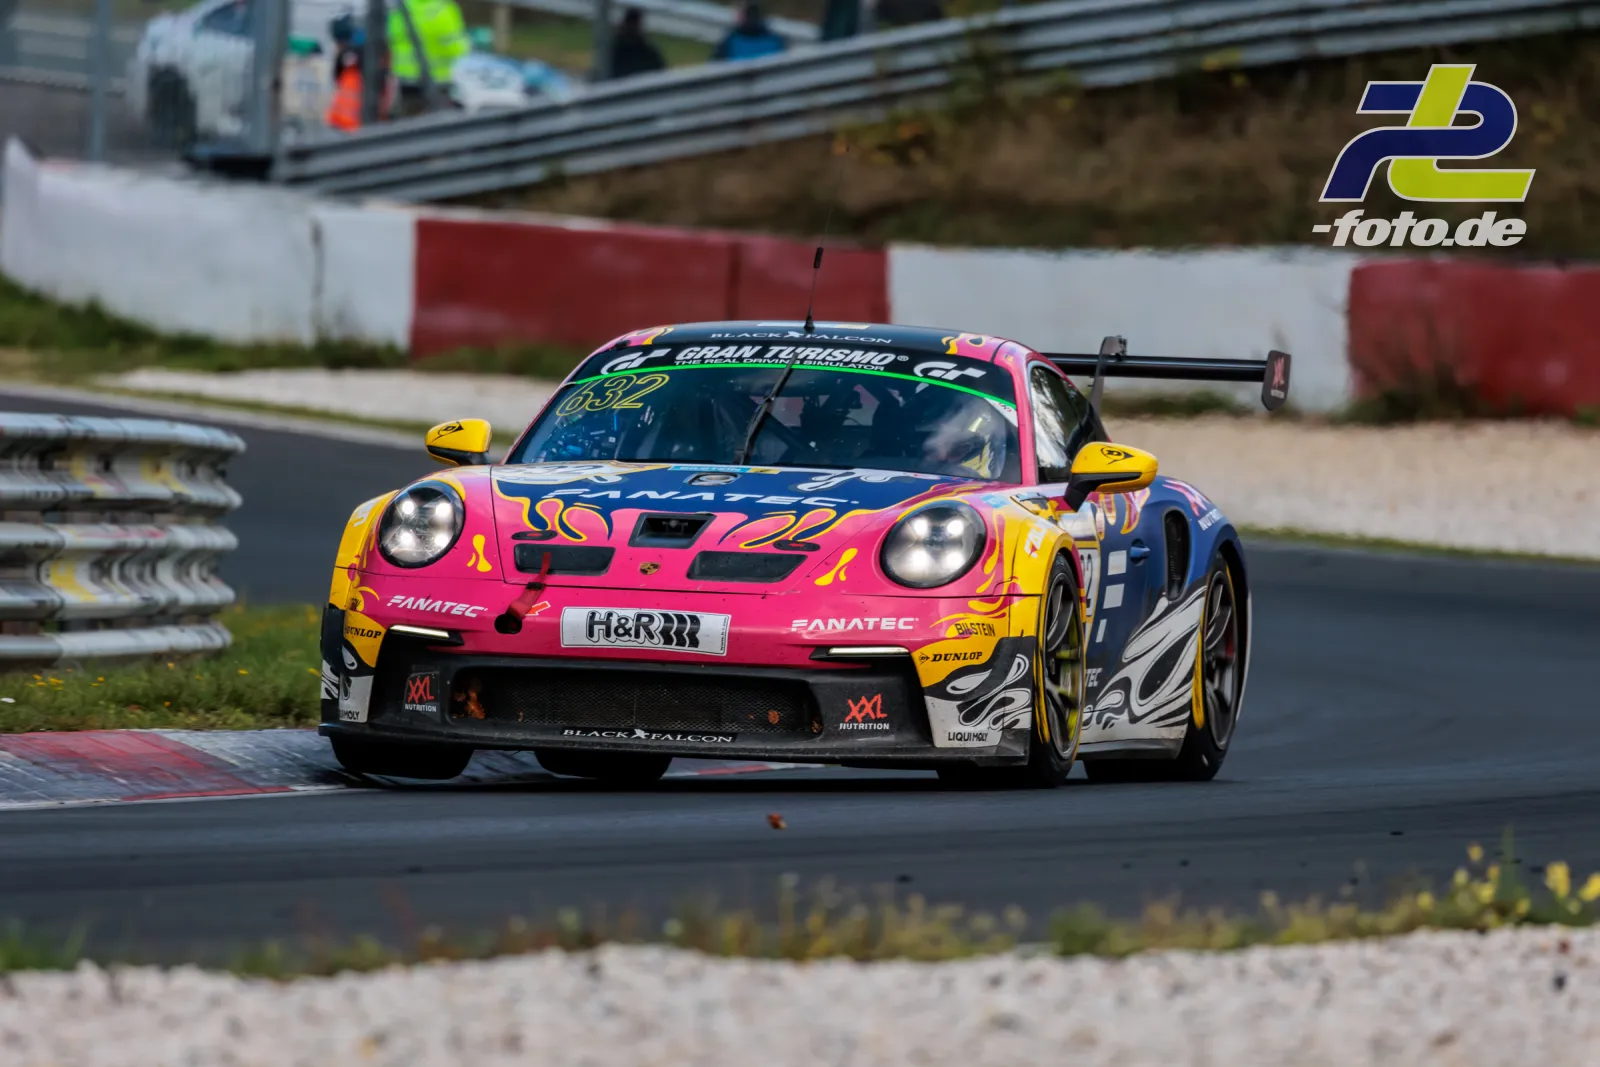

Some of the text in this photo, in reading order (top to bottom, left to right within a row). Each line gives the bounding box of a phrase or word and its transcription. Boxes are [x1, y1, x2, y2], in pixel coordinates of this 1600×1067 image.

[804, 333, 893, 344] FALCON
[675, 345, 762, 361] GRAN
[704, 357, 739, 365] REAL
[802, 359, 885, 372] SIMULATOR
[556, 373, 670, 417] 632
[386, 595, 486, 618] FANATEC
[587, 611, 659, 643] H&R
[791, 617, 916, 632] FANATEC
[954, 622, 997, 637] BILSTEIN
[931, 651, 983, 663] DUNLOP
[407, 675, 435, 704] XXL
[404, 703, 437, 713] NUTRITION
[845, 693, 889, 723] XXL
[839, 722, 890, 731] NUTRITION
[563, 729, 733, 743] BLACK FALCON
[948, 731, 972, 742] LIQUI
